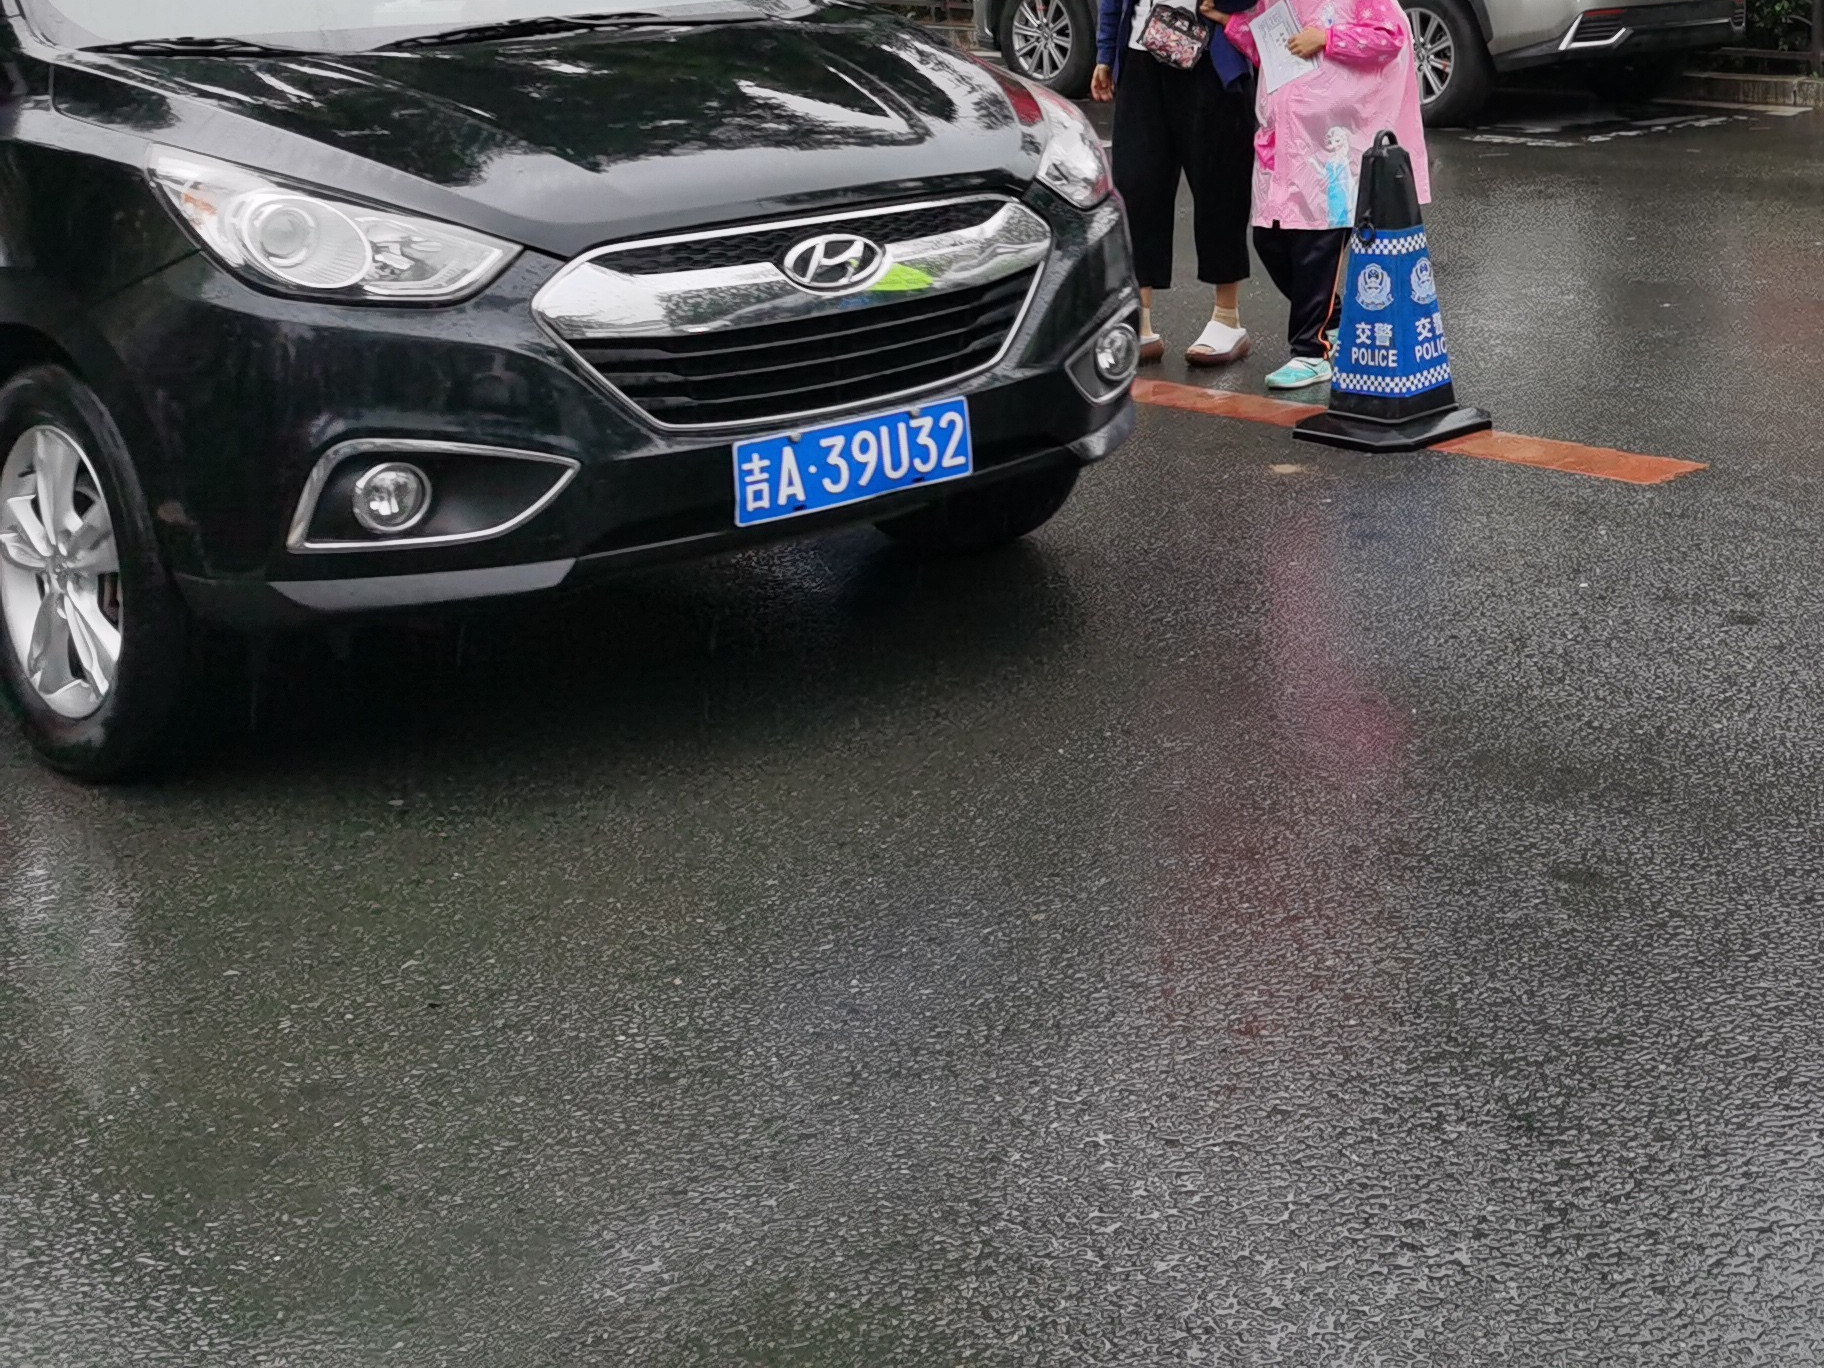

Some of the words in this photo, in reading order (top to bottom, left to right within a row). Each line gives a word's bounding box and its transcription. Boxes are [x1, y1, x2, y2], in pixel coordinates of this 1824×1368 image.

[1355, 322, 1393, 347] 交警
[1351, 346, 1398, 368] POLICE
[741, 410, 967, 512] 吉A·39U32
